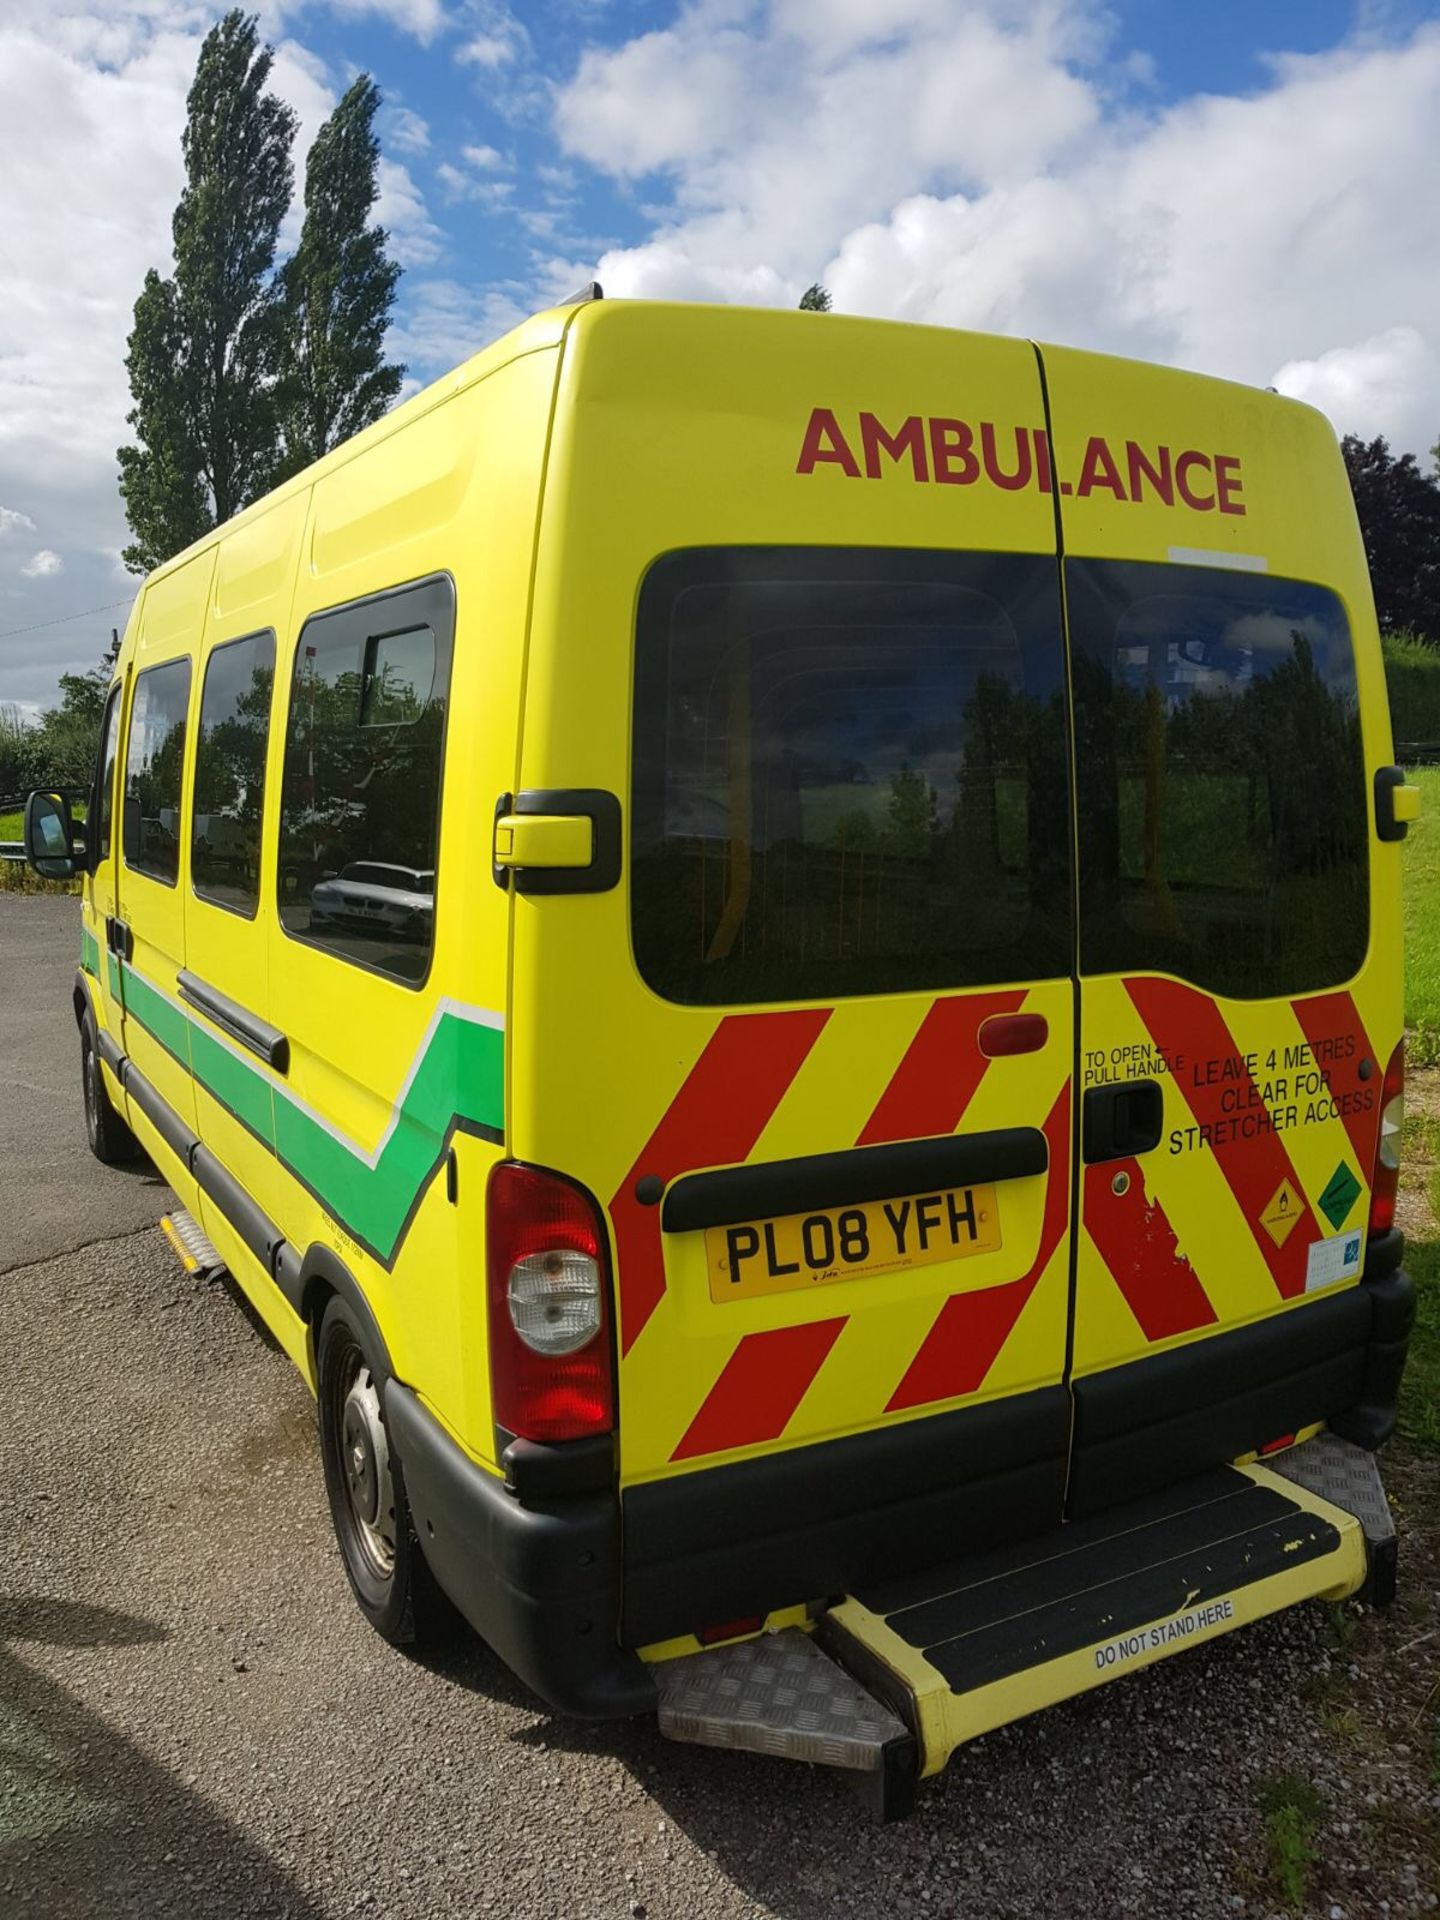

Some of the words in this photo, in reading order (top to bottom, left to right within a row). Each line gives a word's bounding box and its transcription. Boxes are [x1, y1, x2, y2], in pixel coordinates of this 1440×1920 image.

[795, 408, 1246, 516] AMBULANCE
[1085, 1051, 1105, 1068] TO
[1111, 1044, 1151, 1065] OPEN
[1085, 1066, 1121, 1086] PULL
[1126, 1055, 1184, 1078] HANDLE
[1193, 1053, 1258, 1087] LEAVE
[1266, 1049, 1277, 1071] 4
[1284, 1034, 1355, 1069] METRES
[1169, 1105, 1297, 1155] STRETCHER
[1304, 1088, 1373, 1125] ACCESS
[1221, 1078, 1287, 1113] CLEAR
[1295, 1070, 1331, 1098] FOR
[726, 1209, 869, 1283] PL08
[883, 1190, 977, 1255] YFH
[1095, 1646, 1116, 1669] DO
[1119, 1633, 1147, 1660] NOT
[1151, 1616, 1194, 1647] STAND
[1197, 1600, 1233, 1627] HERE
